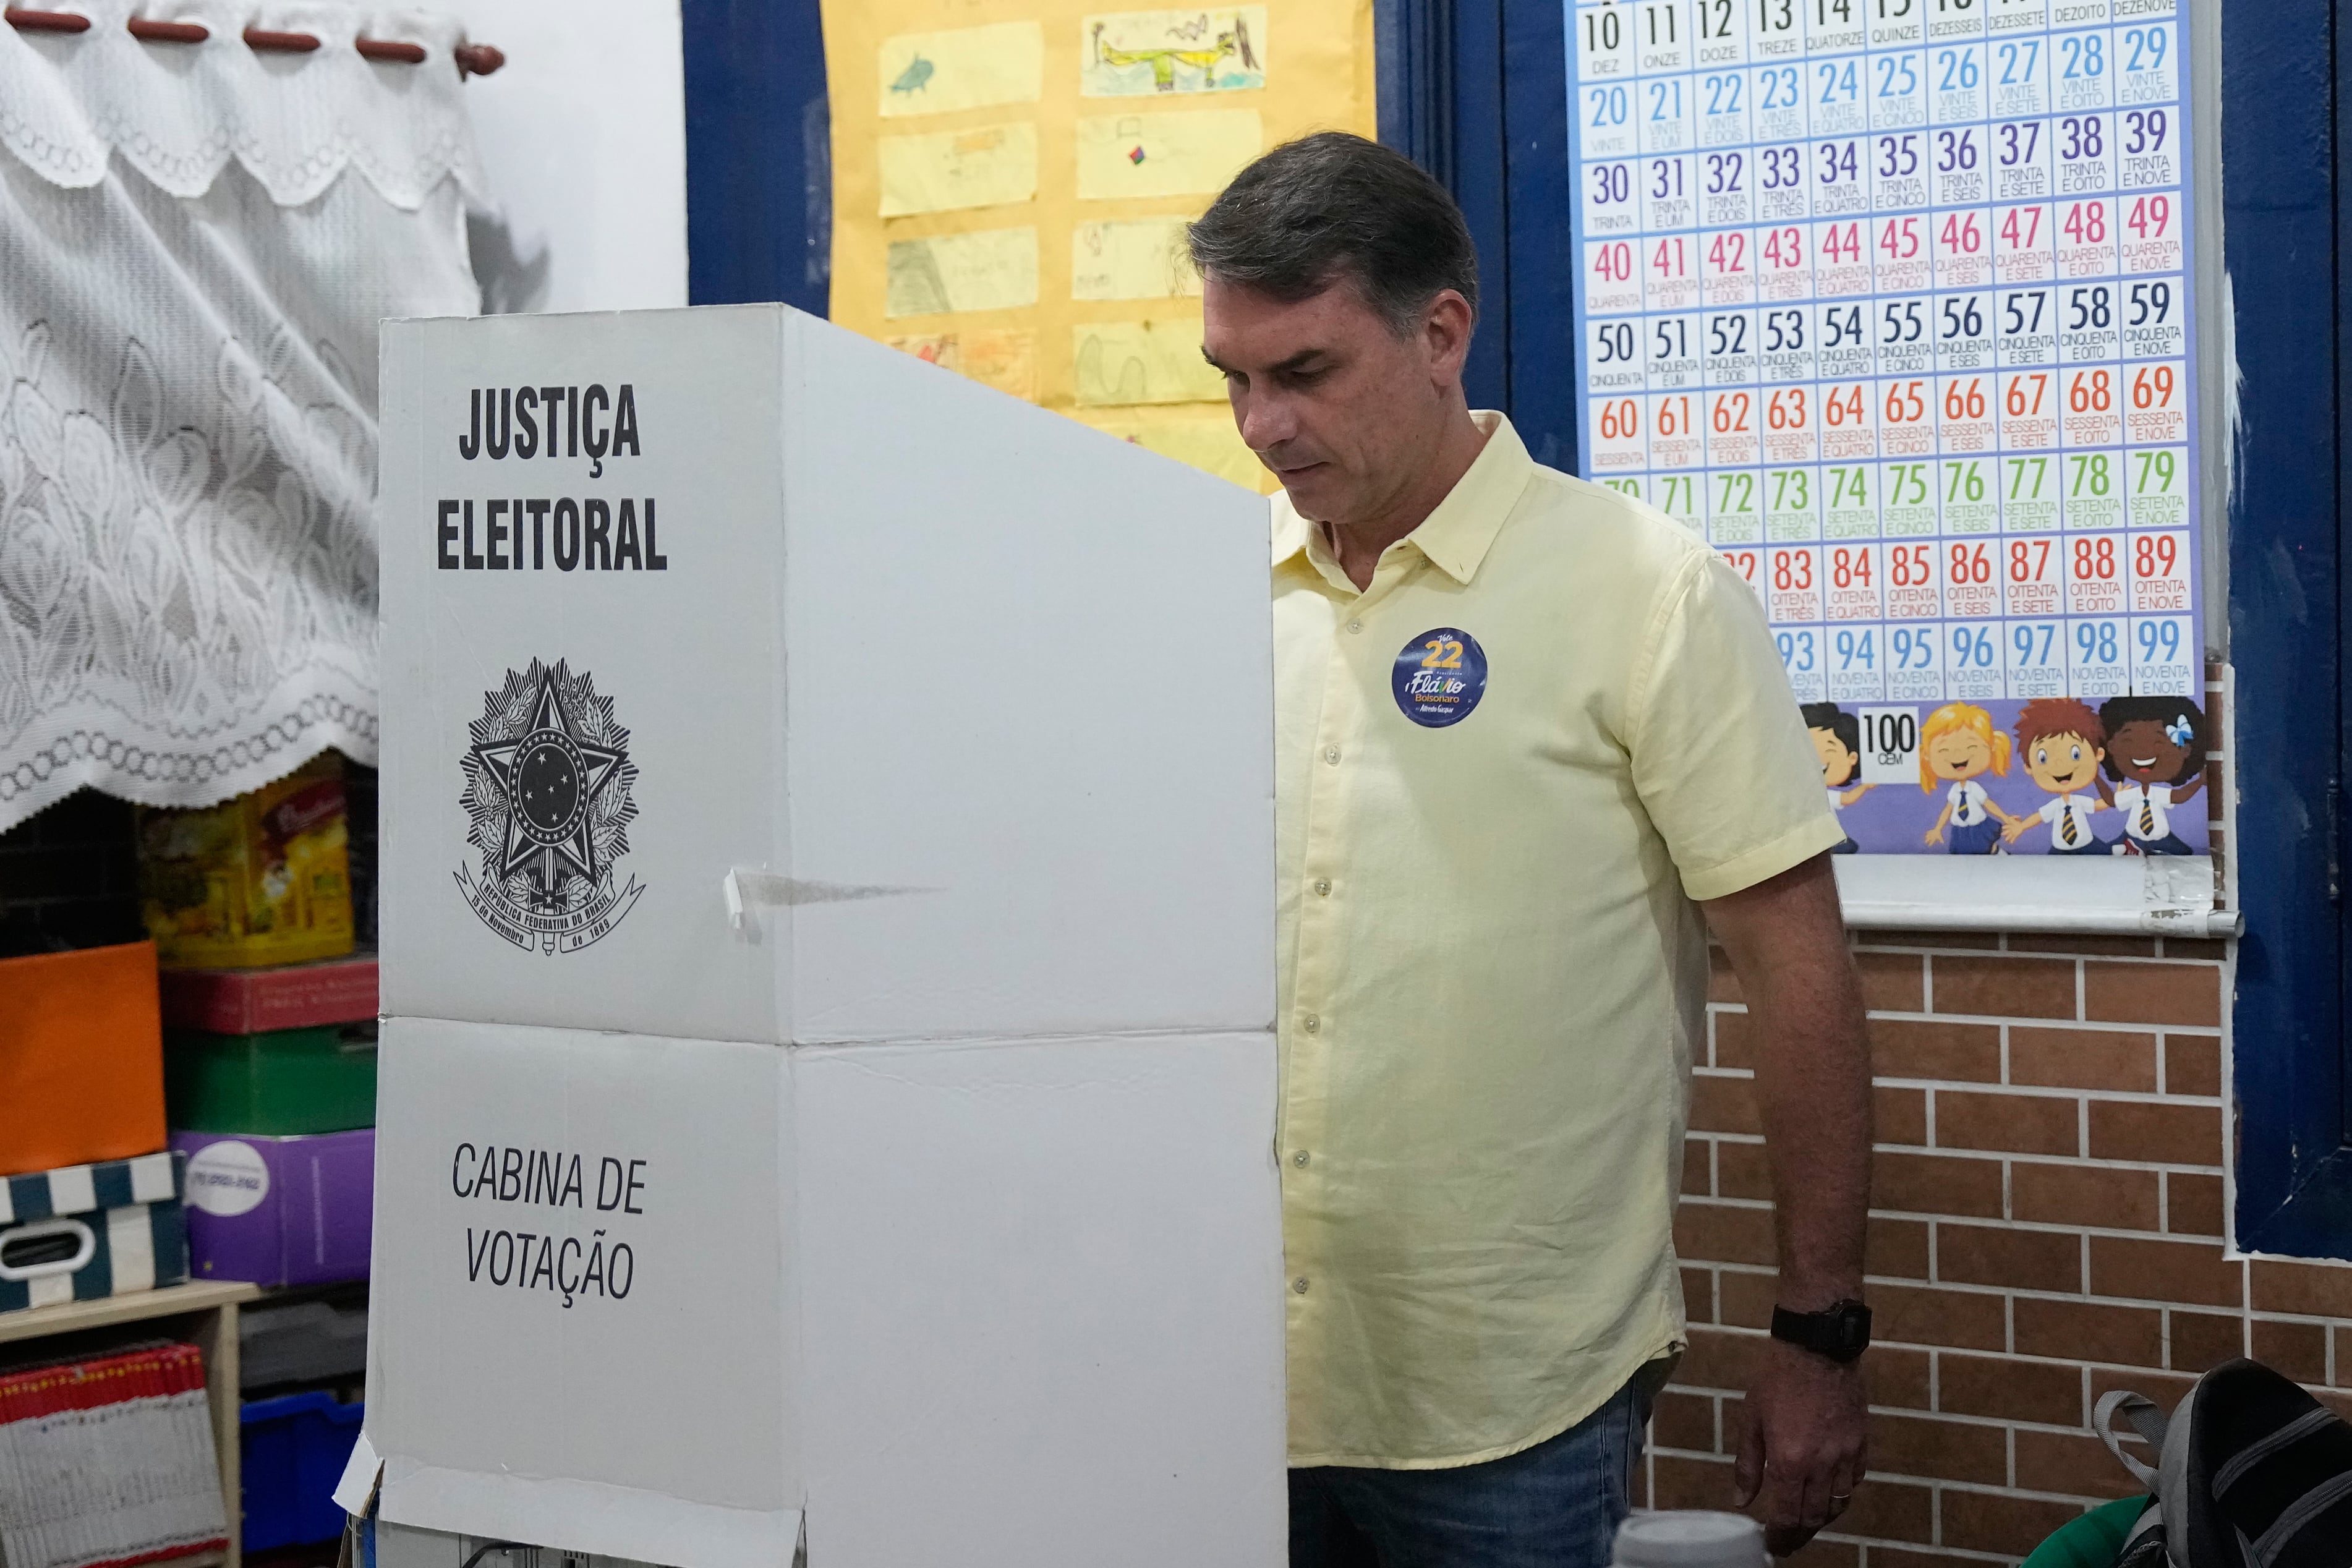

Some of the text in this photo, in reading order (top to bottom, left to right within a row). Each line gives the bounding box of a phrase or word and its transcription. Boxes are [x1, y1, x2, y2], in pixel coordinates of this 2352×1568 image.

[1647, 5, 1675, 45] 11
[1698, 0, 1732, 39] 12
[1761, 0, 1792, 32] 13
[1930, 18, 1982, 36] DEZESSEIS
[1990, 11, 2045, 30] DEZESSETE
[2055, 4, 2105, 22] DEZOITO
[2114, 0, 2176, 16] DEZENOVE
[1586, 11, 1619, 51] 10
[1757, 38, 1797, 55] TREZE
[1807, 31, 1865, 49] QUATORZE
[1872, 25, 1920, 43] QUINZE
[2125, 27, 2167, 71] 29
[1592, 59, 1619, 74] DEZ
[1643, 52, 1681, 68] ONZE
[1701, 45, 1737, 62] DOZE
[1939, 48, 1978, 91] 26
[1999, 40, 2039, 84] 27
[2062, 35, 2103, 79] 28
[1706, 74, 1742, 115] 22
[1761, 67, 1798, 109] 23
[1819, 61, 1857, 103] 24
[1878, 54, 1916, 97] 25
[2122, 85, 2171, 103] E NOVE
[2127, 71, 2165, 87] VINTE
[1591, 87, 1626, 126] 20
[1650, 80, 1681, 121] 21
[1938, 129, 1977, 171] 36
[2000, 122, 2040, 165] 37
[2062, 116, 2102, 160] 38
[2126, 109, 2166, 153] 39
[1708, 152, 1742, 193] 32
[1763, 147, 1799, 189] 33
[1820, 141, 1857, 183] 34
[1880, 135, 1917, 177] 35
[2061, 161, 2106, 177] TRINTA
[2125, 155, 2170, 171] TRINTA
[1593, 164, 1629, 204] 30
[1653, 158, 1682, 198] 31
[2063, 176, 2105, 192] E OITO
[2124, 169, 2171, 186] E NOVE
[1593, 215, 1633, 229] TRINTA
[1941, 213, 1980, 254] 46
[2001, 207, 2041, 249] 47
[2064, 202, 2105, 244] 48
[2128, 196, 2168, 238] 49
[1654, 239, 1684, 277] 41
[1709, 233, 1745, 273] 42
[1764, 228, 1800, 268] 43
[1823, 223, 1860, 263] 44
[1880, 218, 1918, 258] 45
[2122, 241, 2180, 257] QUARENTA
[1595, 242, 1630, 281] 40
[2131, 255, 2171, 271] E NOVE
[1883, 301, 1922, 343] 55
[1942, 296, 1982, 338] 56
[2005, 291, 2046, 334] 57
[2069, 286, 2110, 330] 58
[2129, 282, 2170, 325] 59
[1598, 322, 1634, 362] 50
[1656, 319, 1685, 359] 51
[1710, 314, 1746, 355] 52
[1766, 310, 1804, 351] 53
[1824, 305, 1863, 347] 54
[2061, 331, 2118, 346] CINQUENTA
[2124, 326, 2181, 343] CINQUENTA
[2073, 346, 2105, 359] E OITO
[2134, 341, 2171, 356] E NOVE
[1826, 385, 1864, 426] 64
[1886, 381, 1924, 422] 65
[1945, 378, 1985, 420] 66
[2007, 374, 2047, 416] 67
[2070, 370, 2110, 412] 68
[2133, 366, 2173, 409] 69
[1601, 399, 1637, 439] 60
[1658, 396, 1689, 435] 61
[1713, 393, 1749, 432] 62
[1769, 389, 1805, 430] 63
[2064, 415, 2121, 430] SESSENTA
[2128, 411, 2184, 427] SESSENTA
[459, 383, 641, 478] JUSTIÇA
[2075, 430, 2110, 444] E OITO
[2136, 426, 2176, 441] E NOVE
[1771, 470, 1807, 510] 73
[1830, 467, 1866, 507] 74
[1890, 464, 1926, 505] 75
[1946, 461, 1983, 502] 76
[2008, 458, 2047, 499] 77
[2071, 454, 2109, 496] 78
[2135, 451, 2174, 493] 79
[1662, 477, 1691, 514] 71
[1718, 474, 1752, 513] 72
[2130, 495, 2184, 510] SETENTA
[438, 497, 667, 571] ELEITORAL
[2136, 510, 2179, 524] E NOVE
[1723, 552, 1758, 590] 2
[1775, 550, 1812, 590] 83
[1834, 547, 1872, 588] 84
[1892, 545, 1930, 586] 85
[1951, 543, 1990, 584] 86
[2011, 540, 2050, 582] 87
[2074, 537, 2115, 580] 88
[2136, 535, 2176, 577] 89
[2070, 582, 2121, 596] OITENTA
[2076, 597, 2116, 611] E OITO
[2135, 579, 2186, 594] OITENTA
[2138, 595, 2183, 610] E NOVE
[1421, 640, 1464, 668] 22
[1438, 634, 1453, 643] Vote
[1777, 631, 1813, 671] 93
[1837, 630, 1874, 670] 94
[1894, 628, 1932, 668] 95
[1953, 626, 1993, 667] 96
[2014, 624, 2055, 666] 97
[2077, 622, 2117, 663] 98
[2139, 620, 2179, 662] 99
[1410, 671, 1466, 694] Flávio
[2136, 665, 2191, 678] NOVENTA
[2143, 681, 2186, 694] E NOVE
[1415, 693, 1459, 703] Bolsonaro
[1864, 714, 1915, 752] 100
[1878, 753, 1903, 764] CEM
[472, 894, 610, 947] 15 de Novembro de 1889
[484, 883, 611, 930] REPÚBLICA FEDERATIVA DO BRASIL
[453, 1143, 647, 1214] CABINA DE
[467, 1229, 633, 1308] VOTAÇÃO
